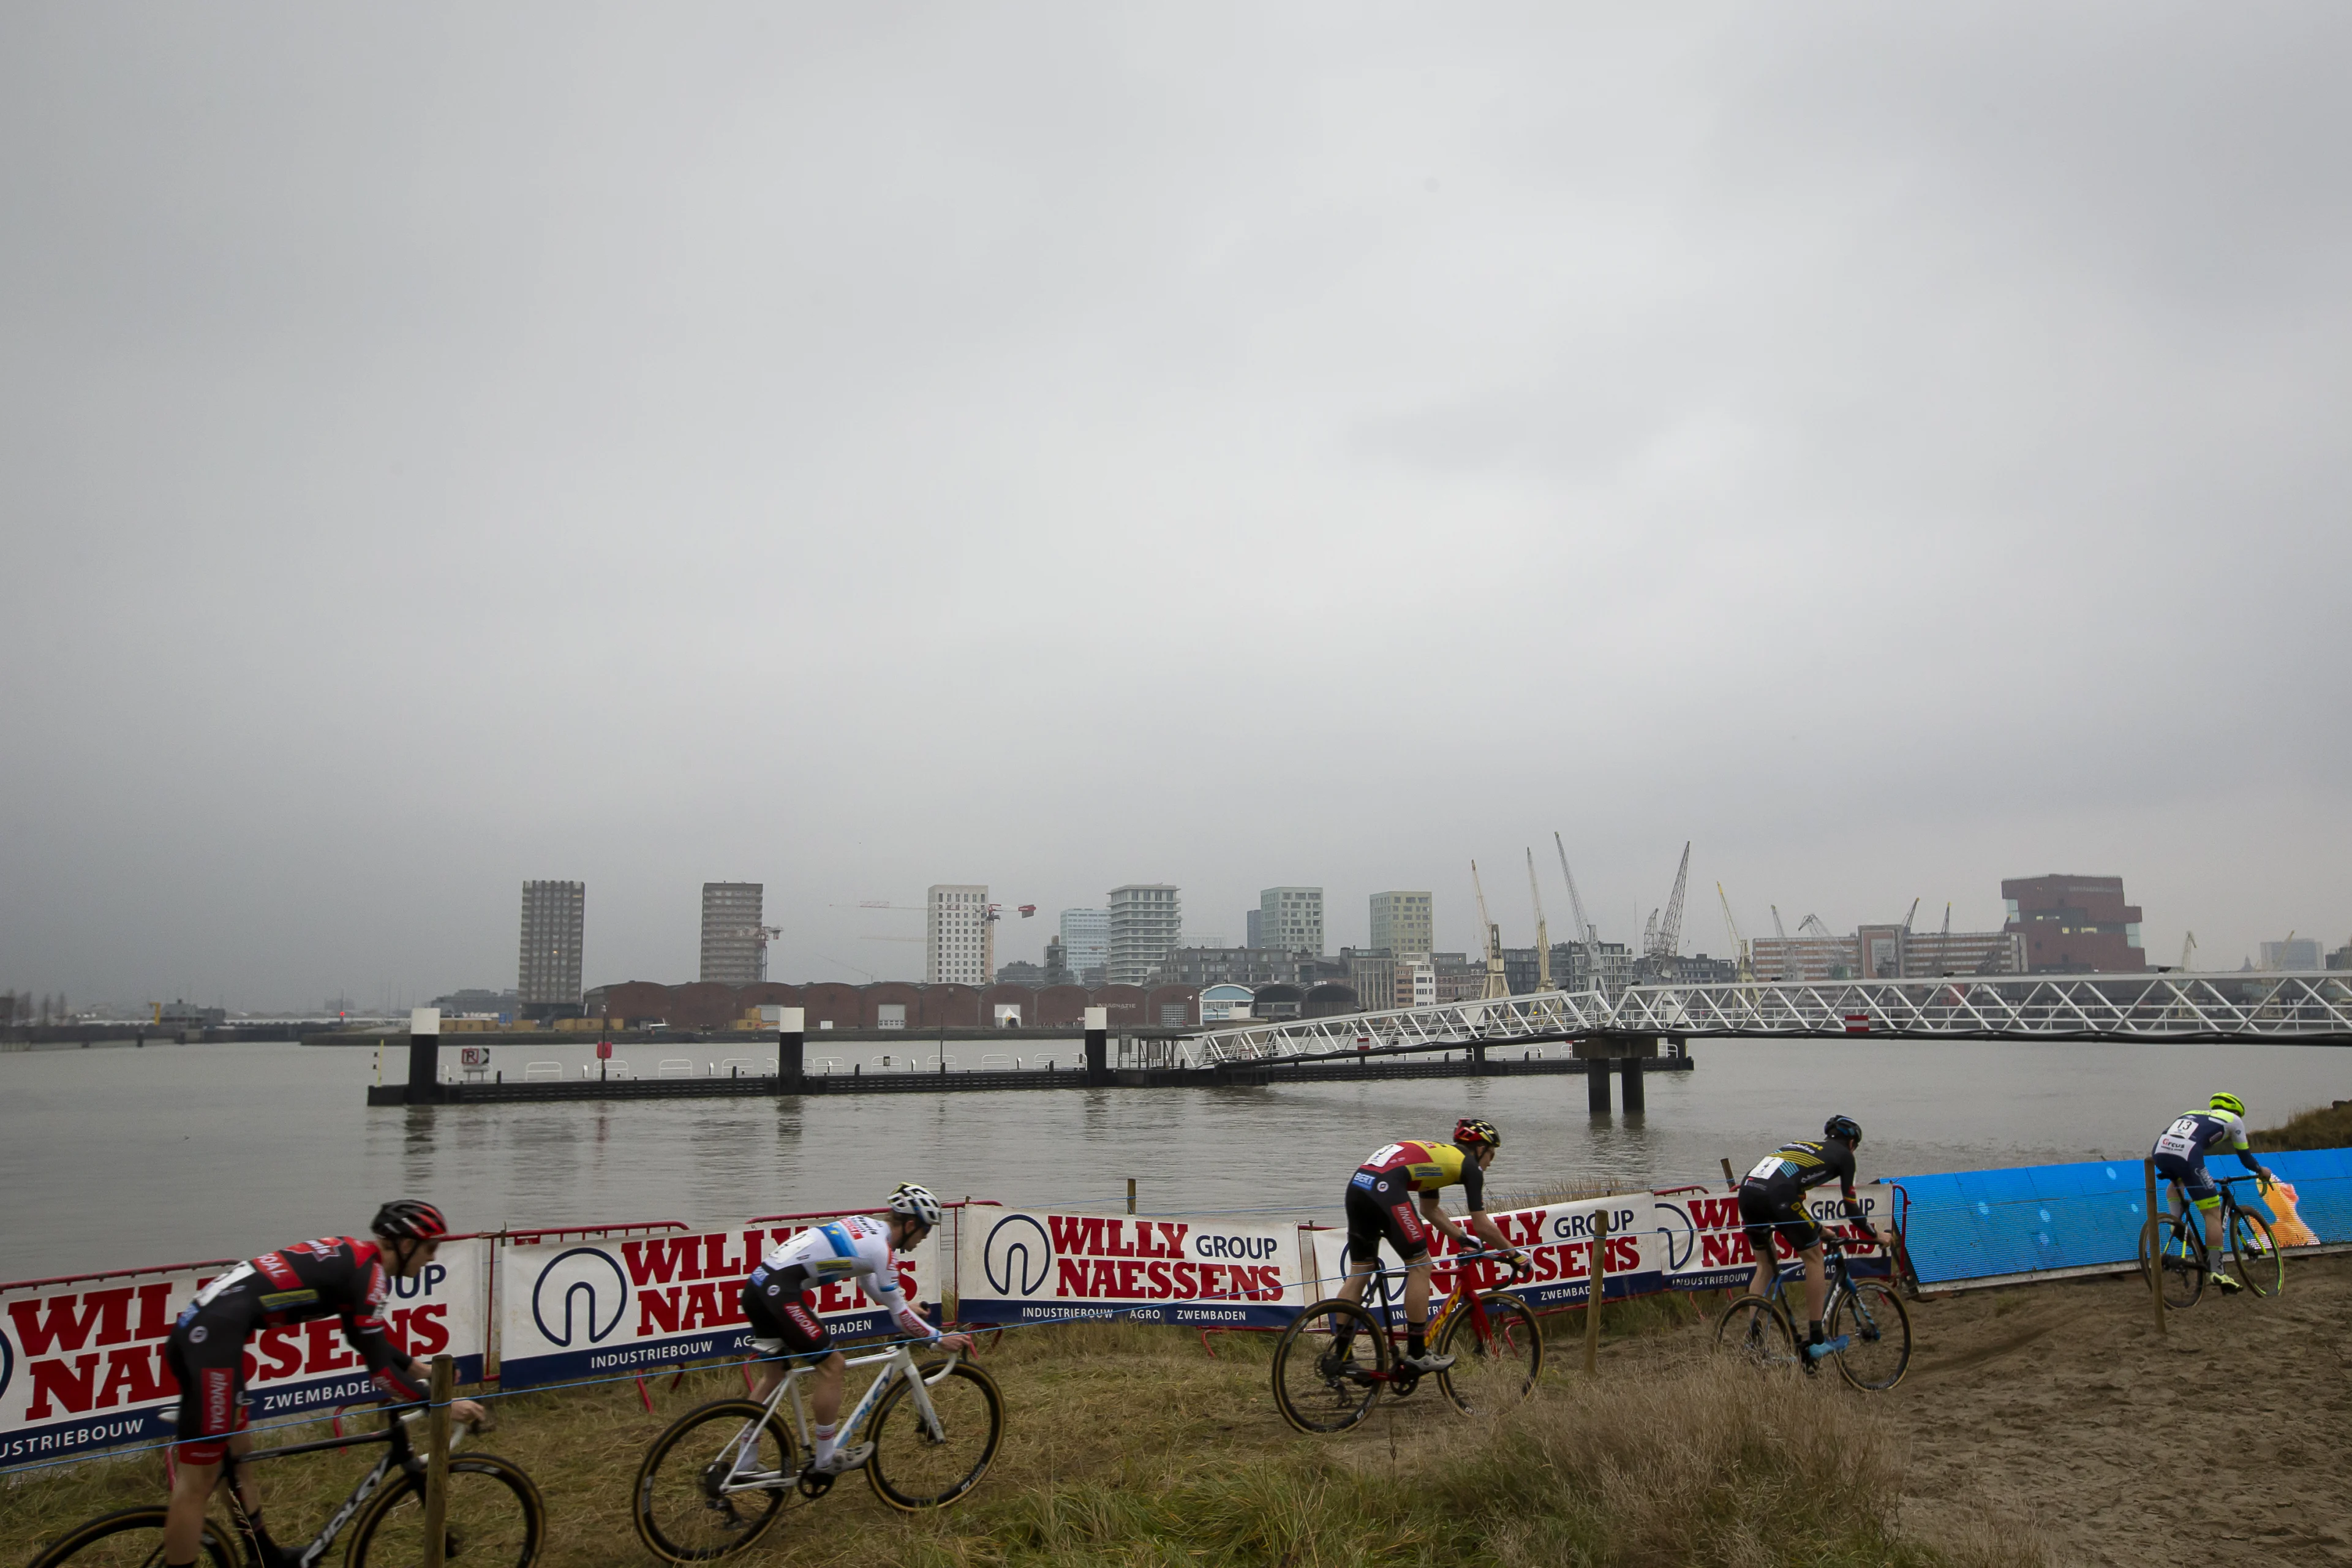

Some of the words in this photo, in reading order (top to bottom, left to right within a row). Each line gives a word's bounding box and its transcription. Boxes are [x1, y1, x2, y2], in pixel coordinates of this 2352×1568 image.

[2177, 1120, 2192, 1130] 13
[1354, 1172, 1376, 1185] BERT
[1048, 1215, 1188, 1259] WILLY
[1196, 1235, 1277, 1260] GROUP
[1056, 1257, 1284, 1302] NAESSENS
[1672, 1273, 1749, 1286] INDUSTRIEBOUW
[1022, 1307, 1114, 1319] INDUSTRIEBOUW
[1129, 1310, 1161, 1319] AGRO
[1177, 1310, 1246, 1321] ZWEMBADEN
[591, 1340, 713, 1369] INDUSTRIEBOUW
[961, 1480, 971, 1493] DT
